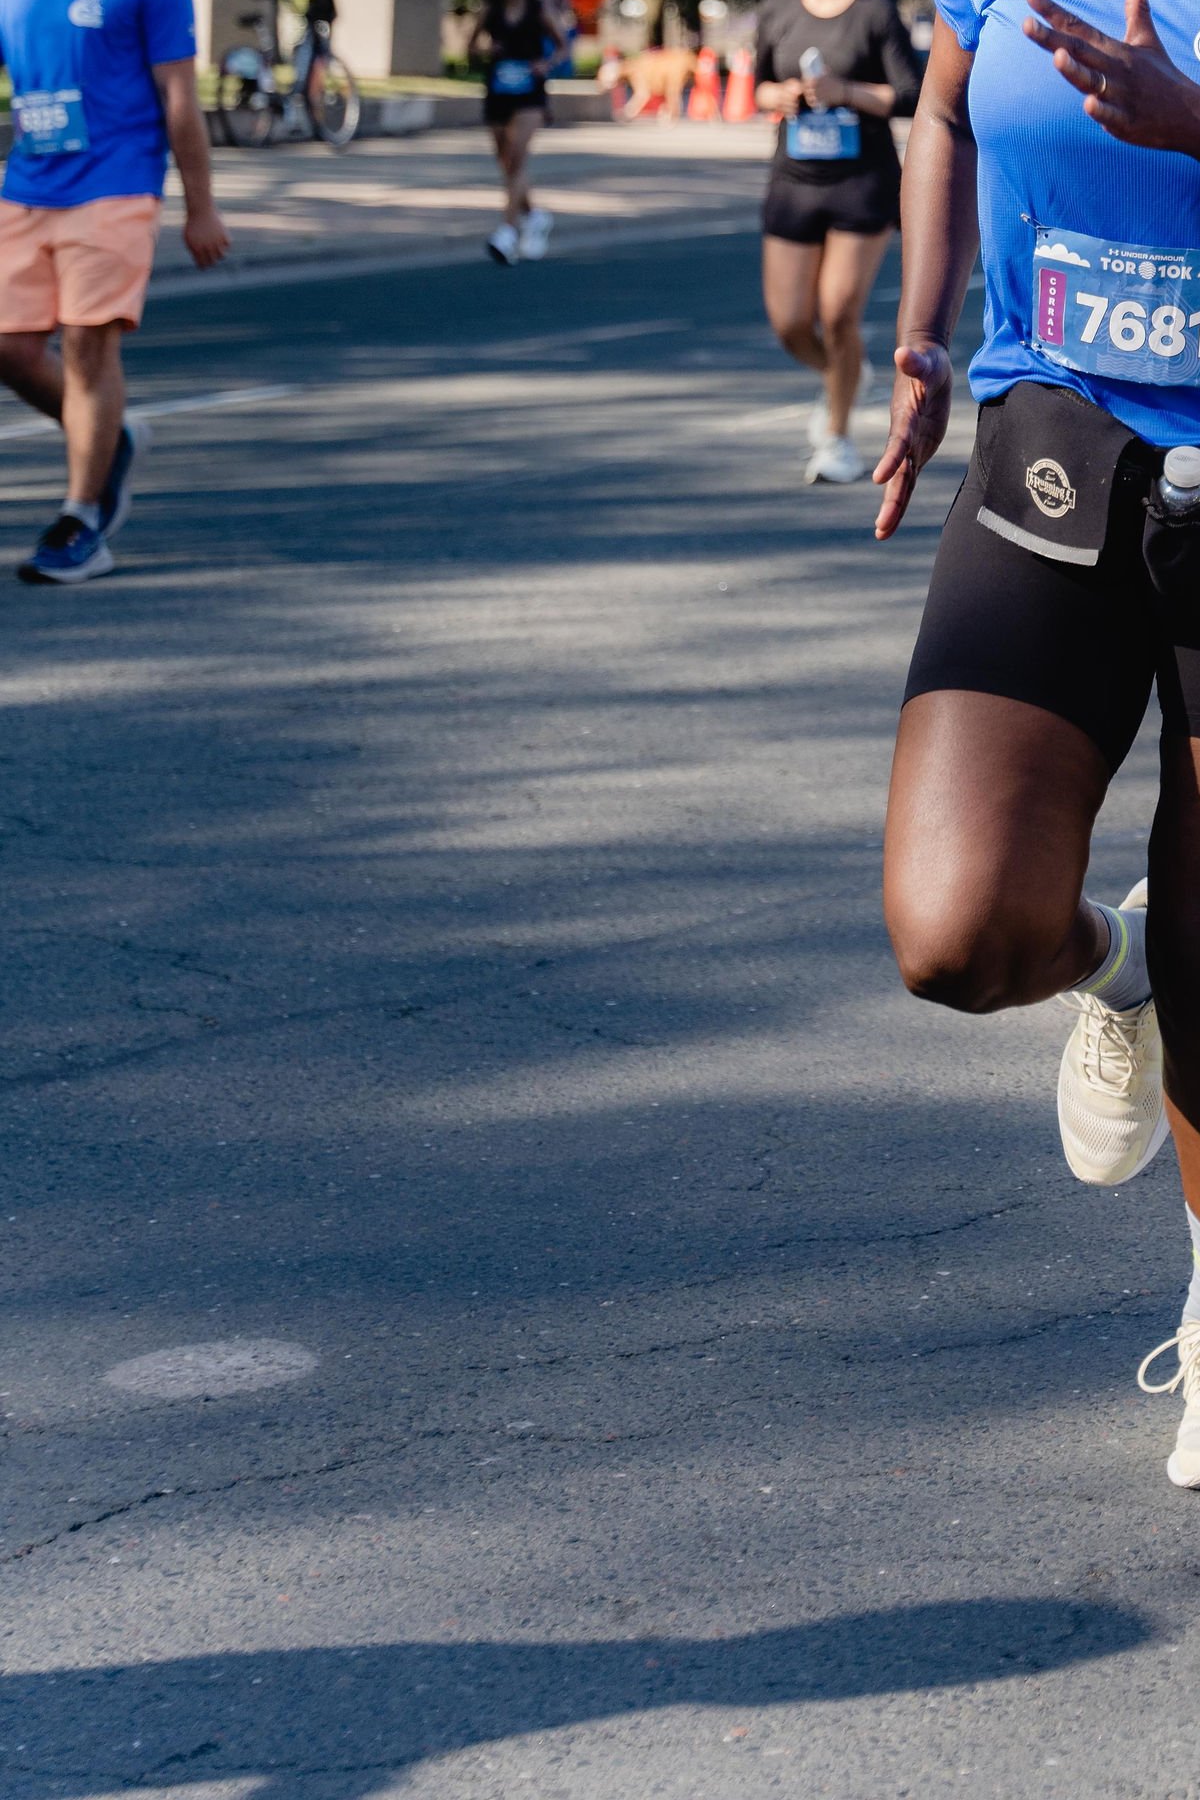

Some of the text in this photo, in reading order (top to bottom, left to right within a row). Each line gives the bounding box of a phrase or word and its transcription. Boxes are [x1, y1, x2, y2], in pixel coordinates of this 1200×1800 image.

[1120, 250, 1185, 262] UNDER ARMOUR
[1100, 257, 1192, 280] TOR 10K
[1047, 277, 1057, 336] CORRAL
